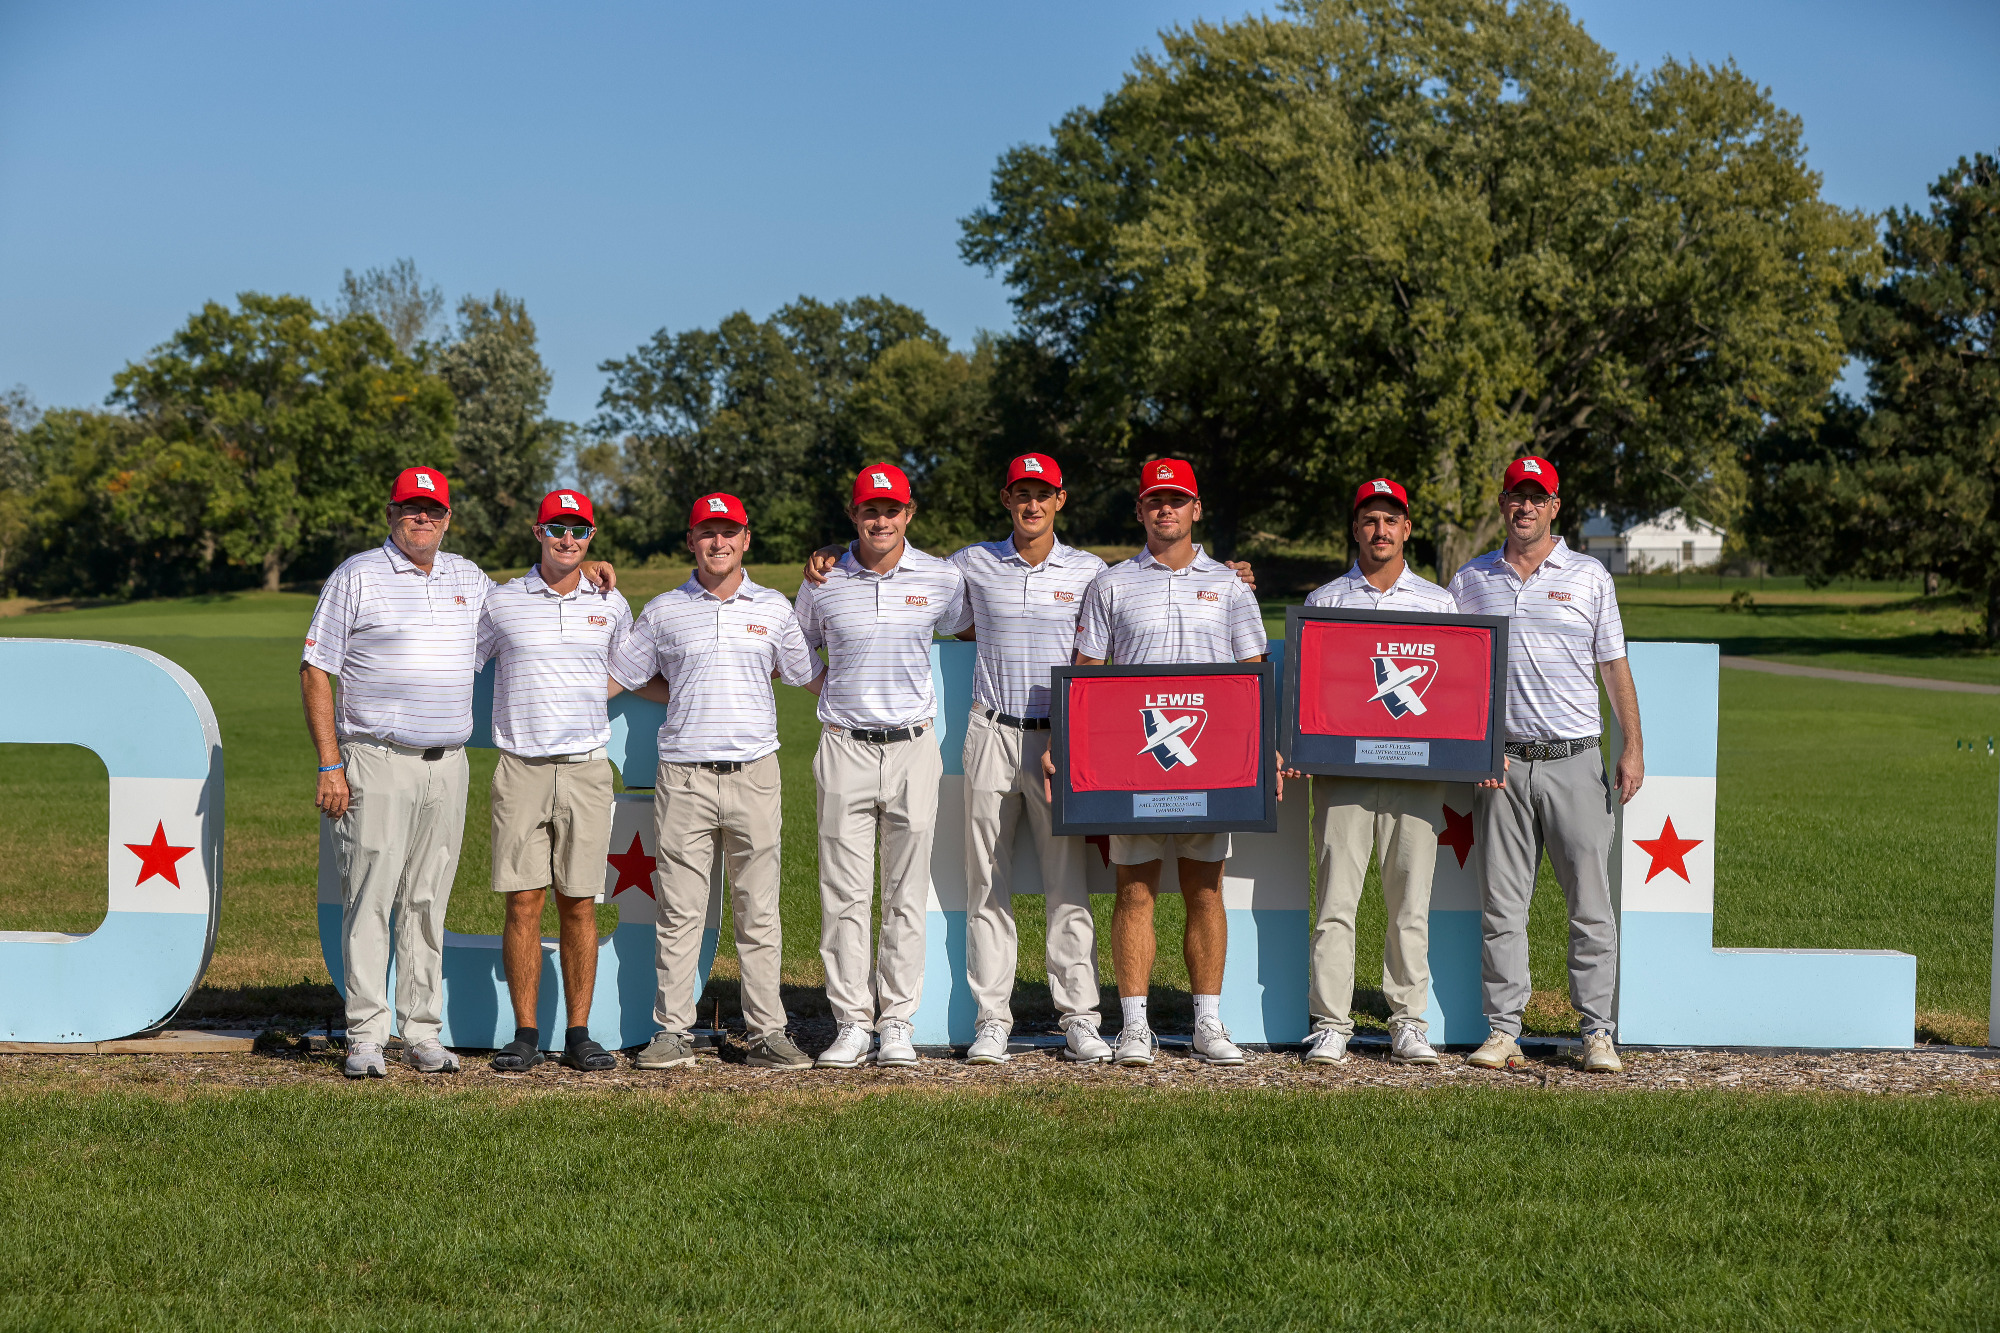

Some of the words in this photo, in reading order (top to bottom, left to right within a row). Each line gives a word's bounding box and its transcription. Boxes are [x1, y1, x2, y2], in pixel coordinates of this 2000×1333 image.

[905, 595, 928, 606] UMSL
[1376, 642, 1436, 656] LEWIS
[1145, 693, 1204, 707] LEWIS
